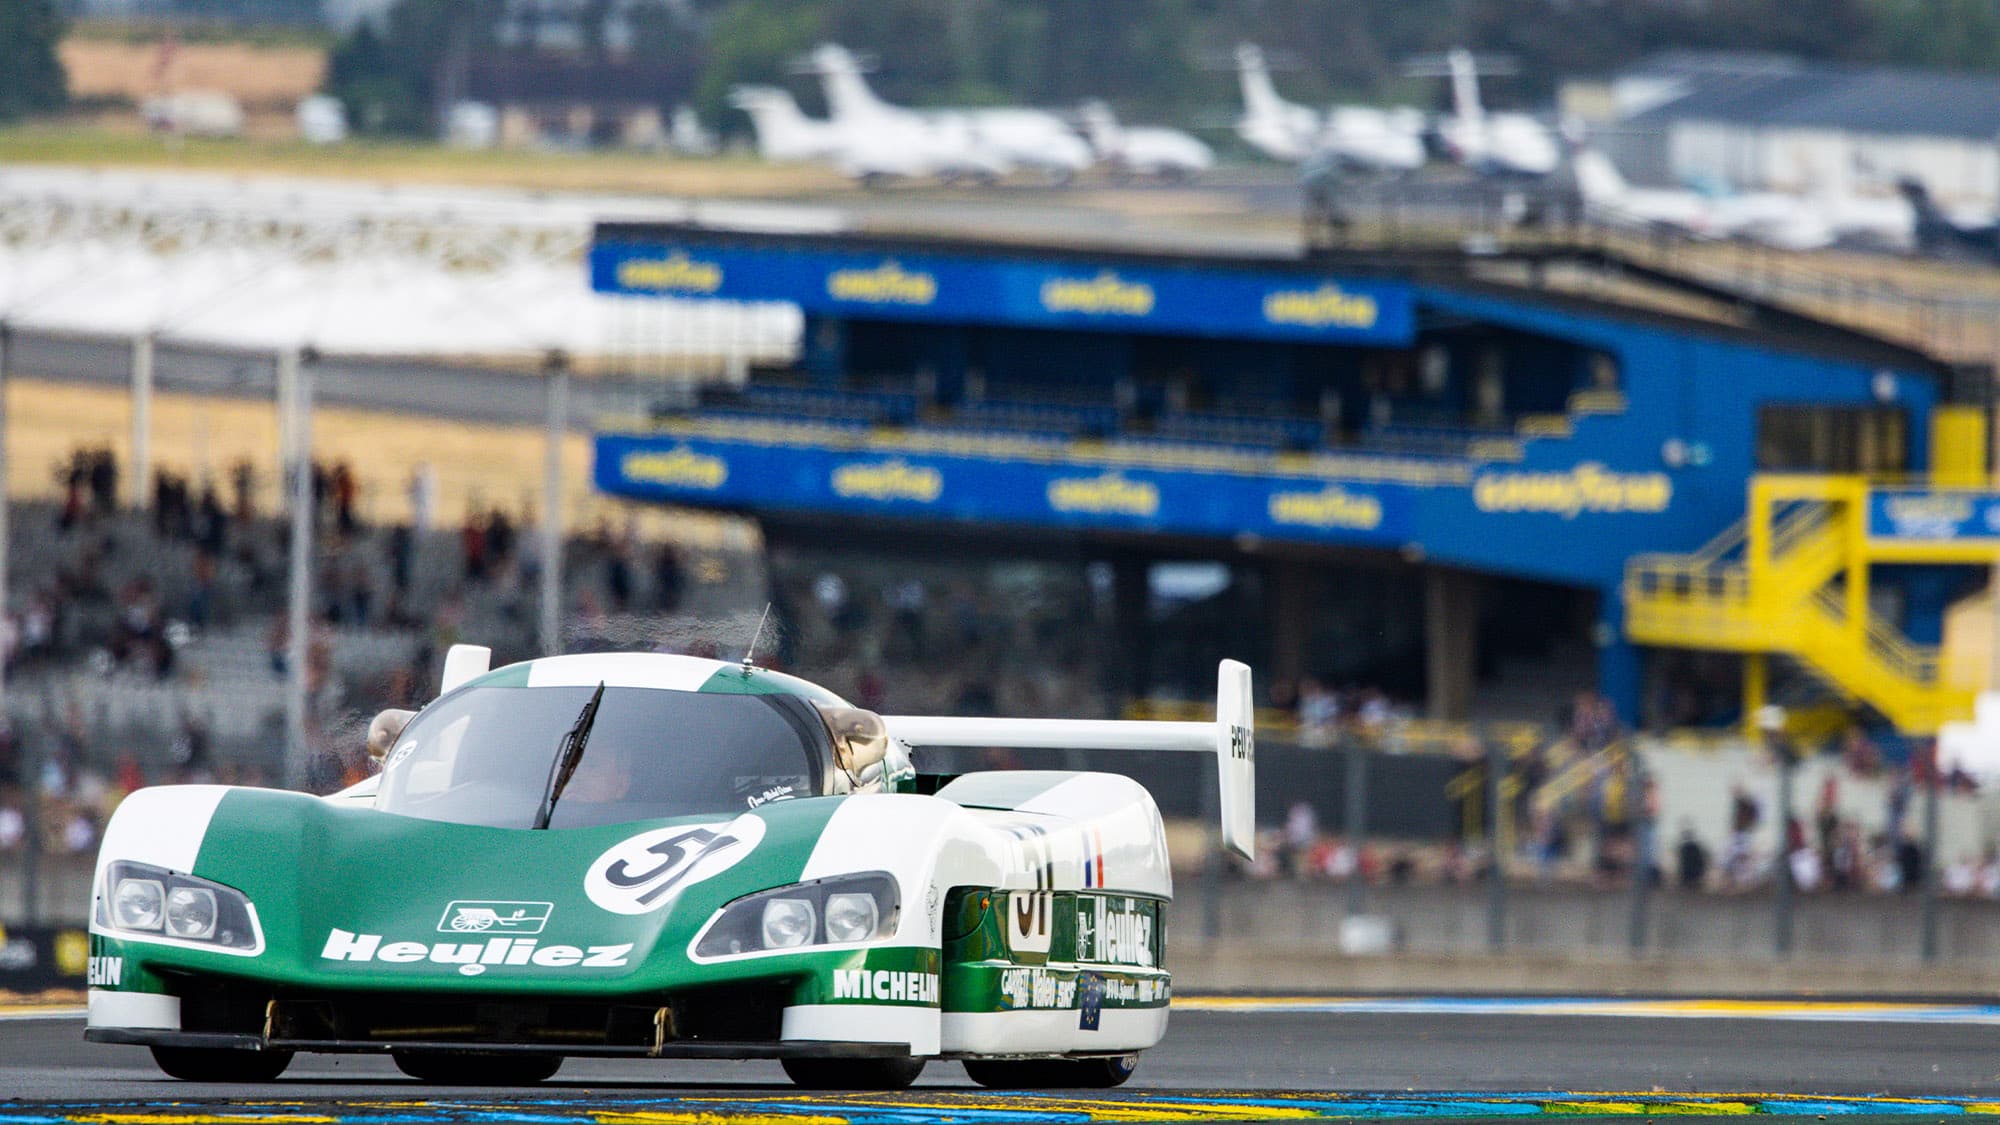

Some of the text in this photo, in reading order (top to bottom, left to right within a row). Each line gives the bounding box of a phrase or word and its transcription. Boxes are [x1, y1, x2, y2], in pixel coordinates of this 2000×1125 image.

[320, 927, 634, 967] Heuliez
[1095, 895, 1152, 966] Heuliez
[833, 969, 939, 1003] MICHELIN
